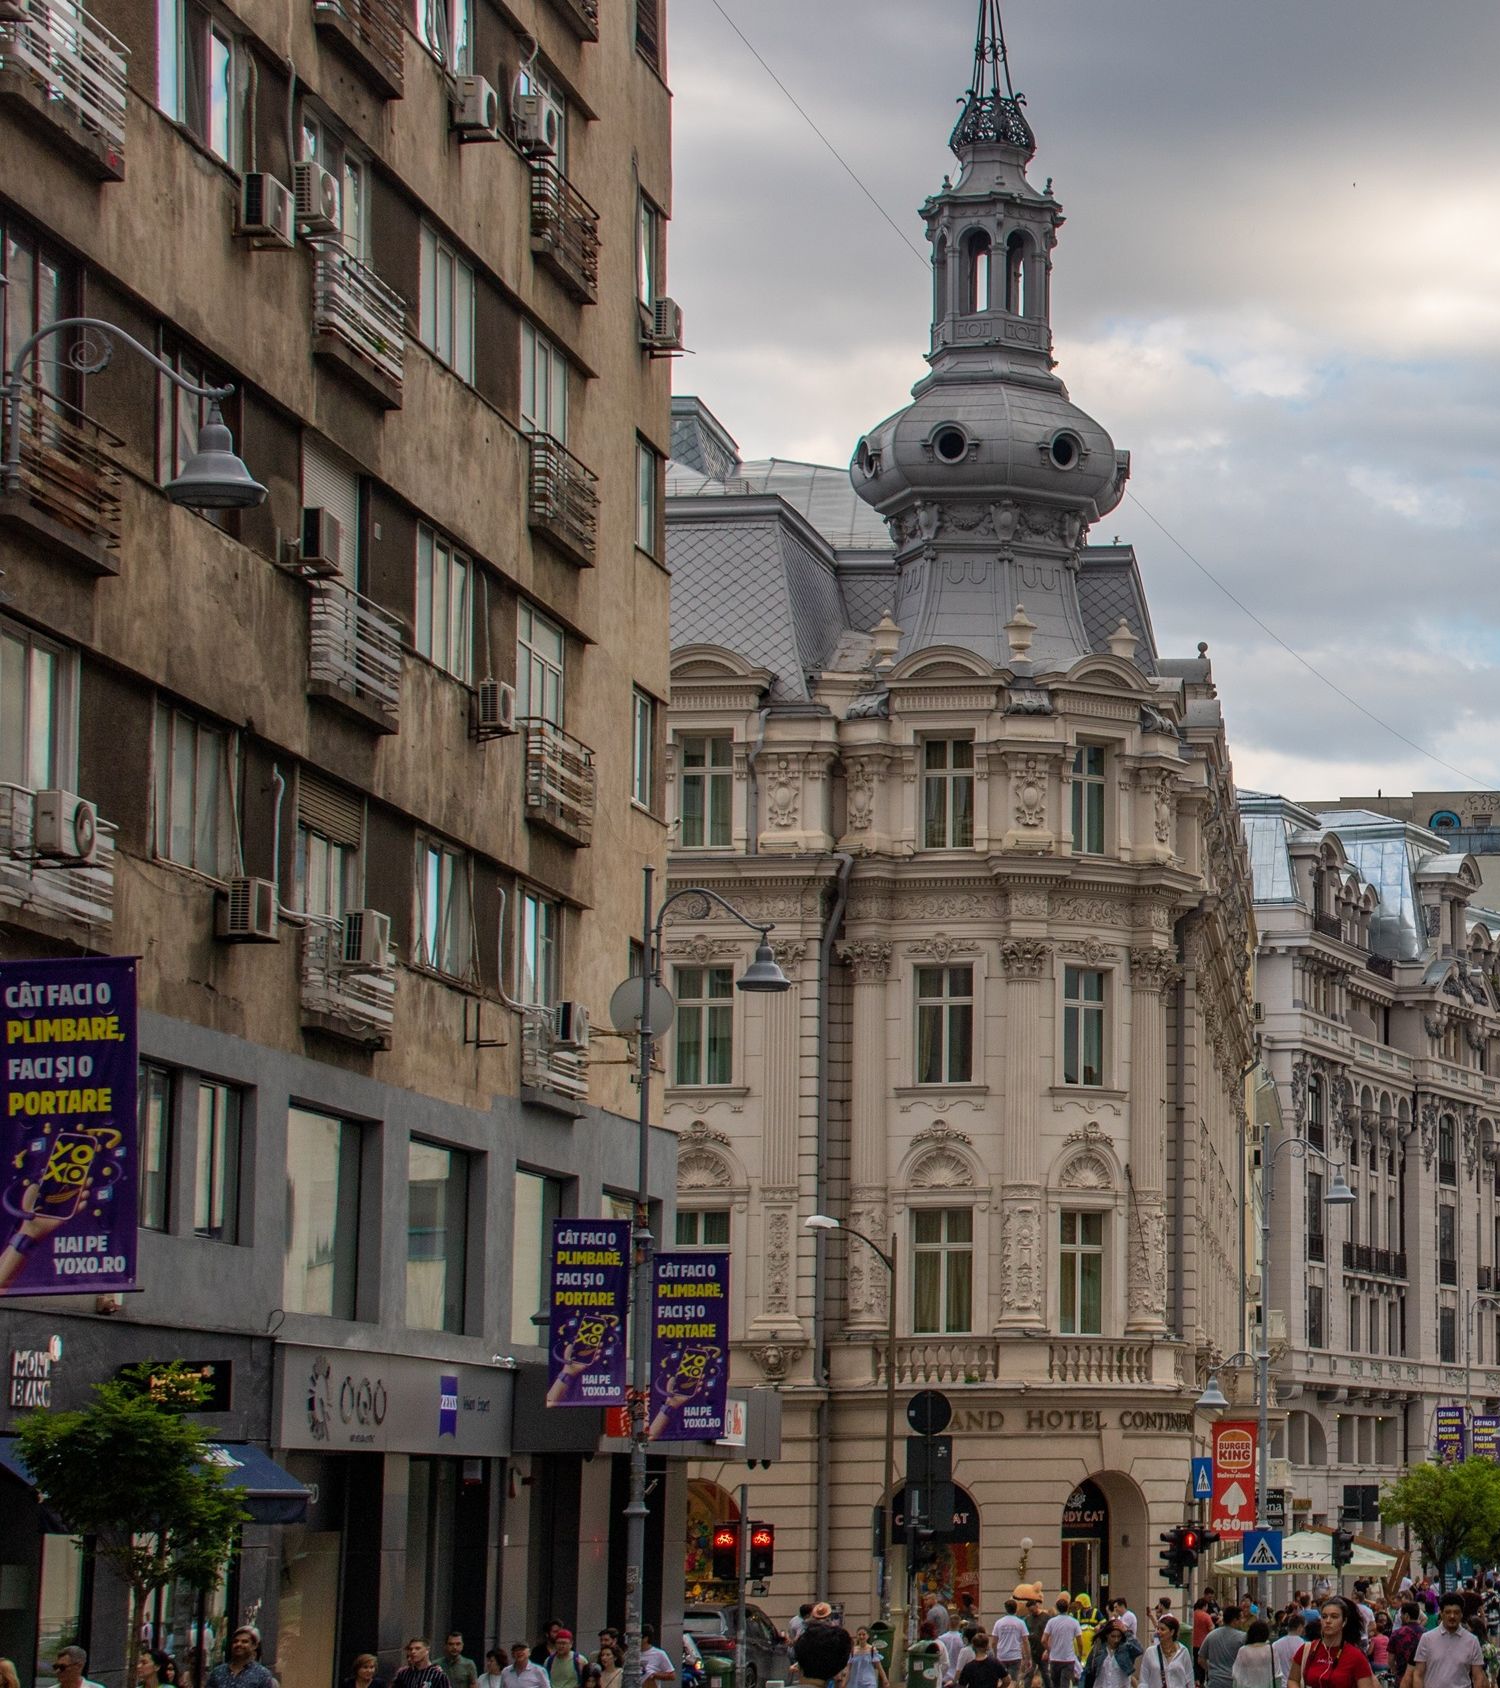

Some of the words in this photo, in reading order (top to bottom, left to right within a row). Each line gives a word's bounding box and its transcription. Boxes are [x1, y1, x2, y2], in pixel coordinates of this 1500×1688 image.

[5, 981, 43, 1008] CÂT
[48, 983, 93, 1006] FACI
[96, 983, 111, 1005] O
[7, 1016, 125, 1044] PLIMBARE,
[8, 1057, 53, 1080] FACI
[56, 1056, 74, 1083] ȘI
[78, 1056, 93, 1077] O
[9, 1088, 112, 1116] PORTARE
[54, 1236, 82, 1253] HAI
[86, 1236, 107, 1252] PE
[557, 1230, 579, 1245] CÂT
[581, 1232, 606, 1245] FACI
[608, 1232, 616, 1245] O
[54, 1256, 126, 1274] YOXO.RO
[557, 1251, 624, 1267] PLIMBARE,
[658, 1263, 680, 1278] CÂT
[681, 1265, 706, 1278] FACI
[707, 1265, 716, 1277] O
[556, 1273, 581, 1285] FACI
[596, 1273, 604, 1285] O
[658, 1284, 724, 1298] PLIMBARE,
[556, 1292, 615, 1306] PORTARE
[658, 1306, 683, 1318] FACI
[697, 1305, 705, 1317] O
[657, 1324, 716, 1338] PORTARE
[14, 1350, 50, 1377] MONT
[582, 1375, 597, 1385] HAI
[599, 1375, 611, 1384] PE
[582, 1386, 621, 1397] YOXO.RO
[683, 1407, 699, 1417] HAI
[701, 1406, 712, 1416] PE
[683, 1418, 721, 1428] YOXO.RO
[951, 1410, 1004, 1430] AND
[1026, 1409, 1107, 1431] HOTEL
[1219, 1442, 1250, 1450] BURGER
[1218, 1450, 1250, 1460] KING
[953, 1513, 969, 1524] AT
[1084, 1510, 1104, 1522] CAT
[1213, 1518, 1253, 1530] 450m
[1283, 1550, 1332, 1561] 827
